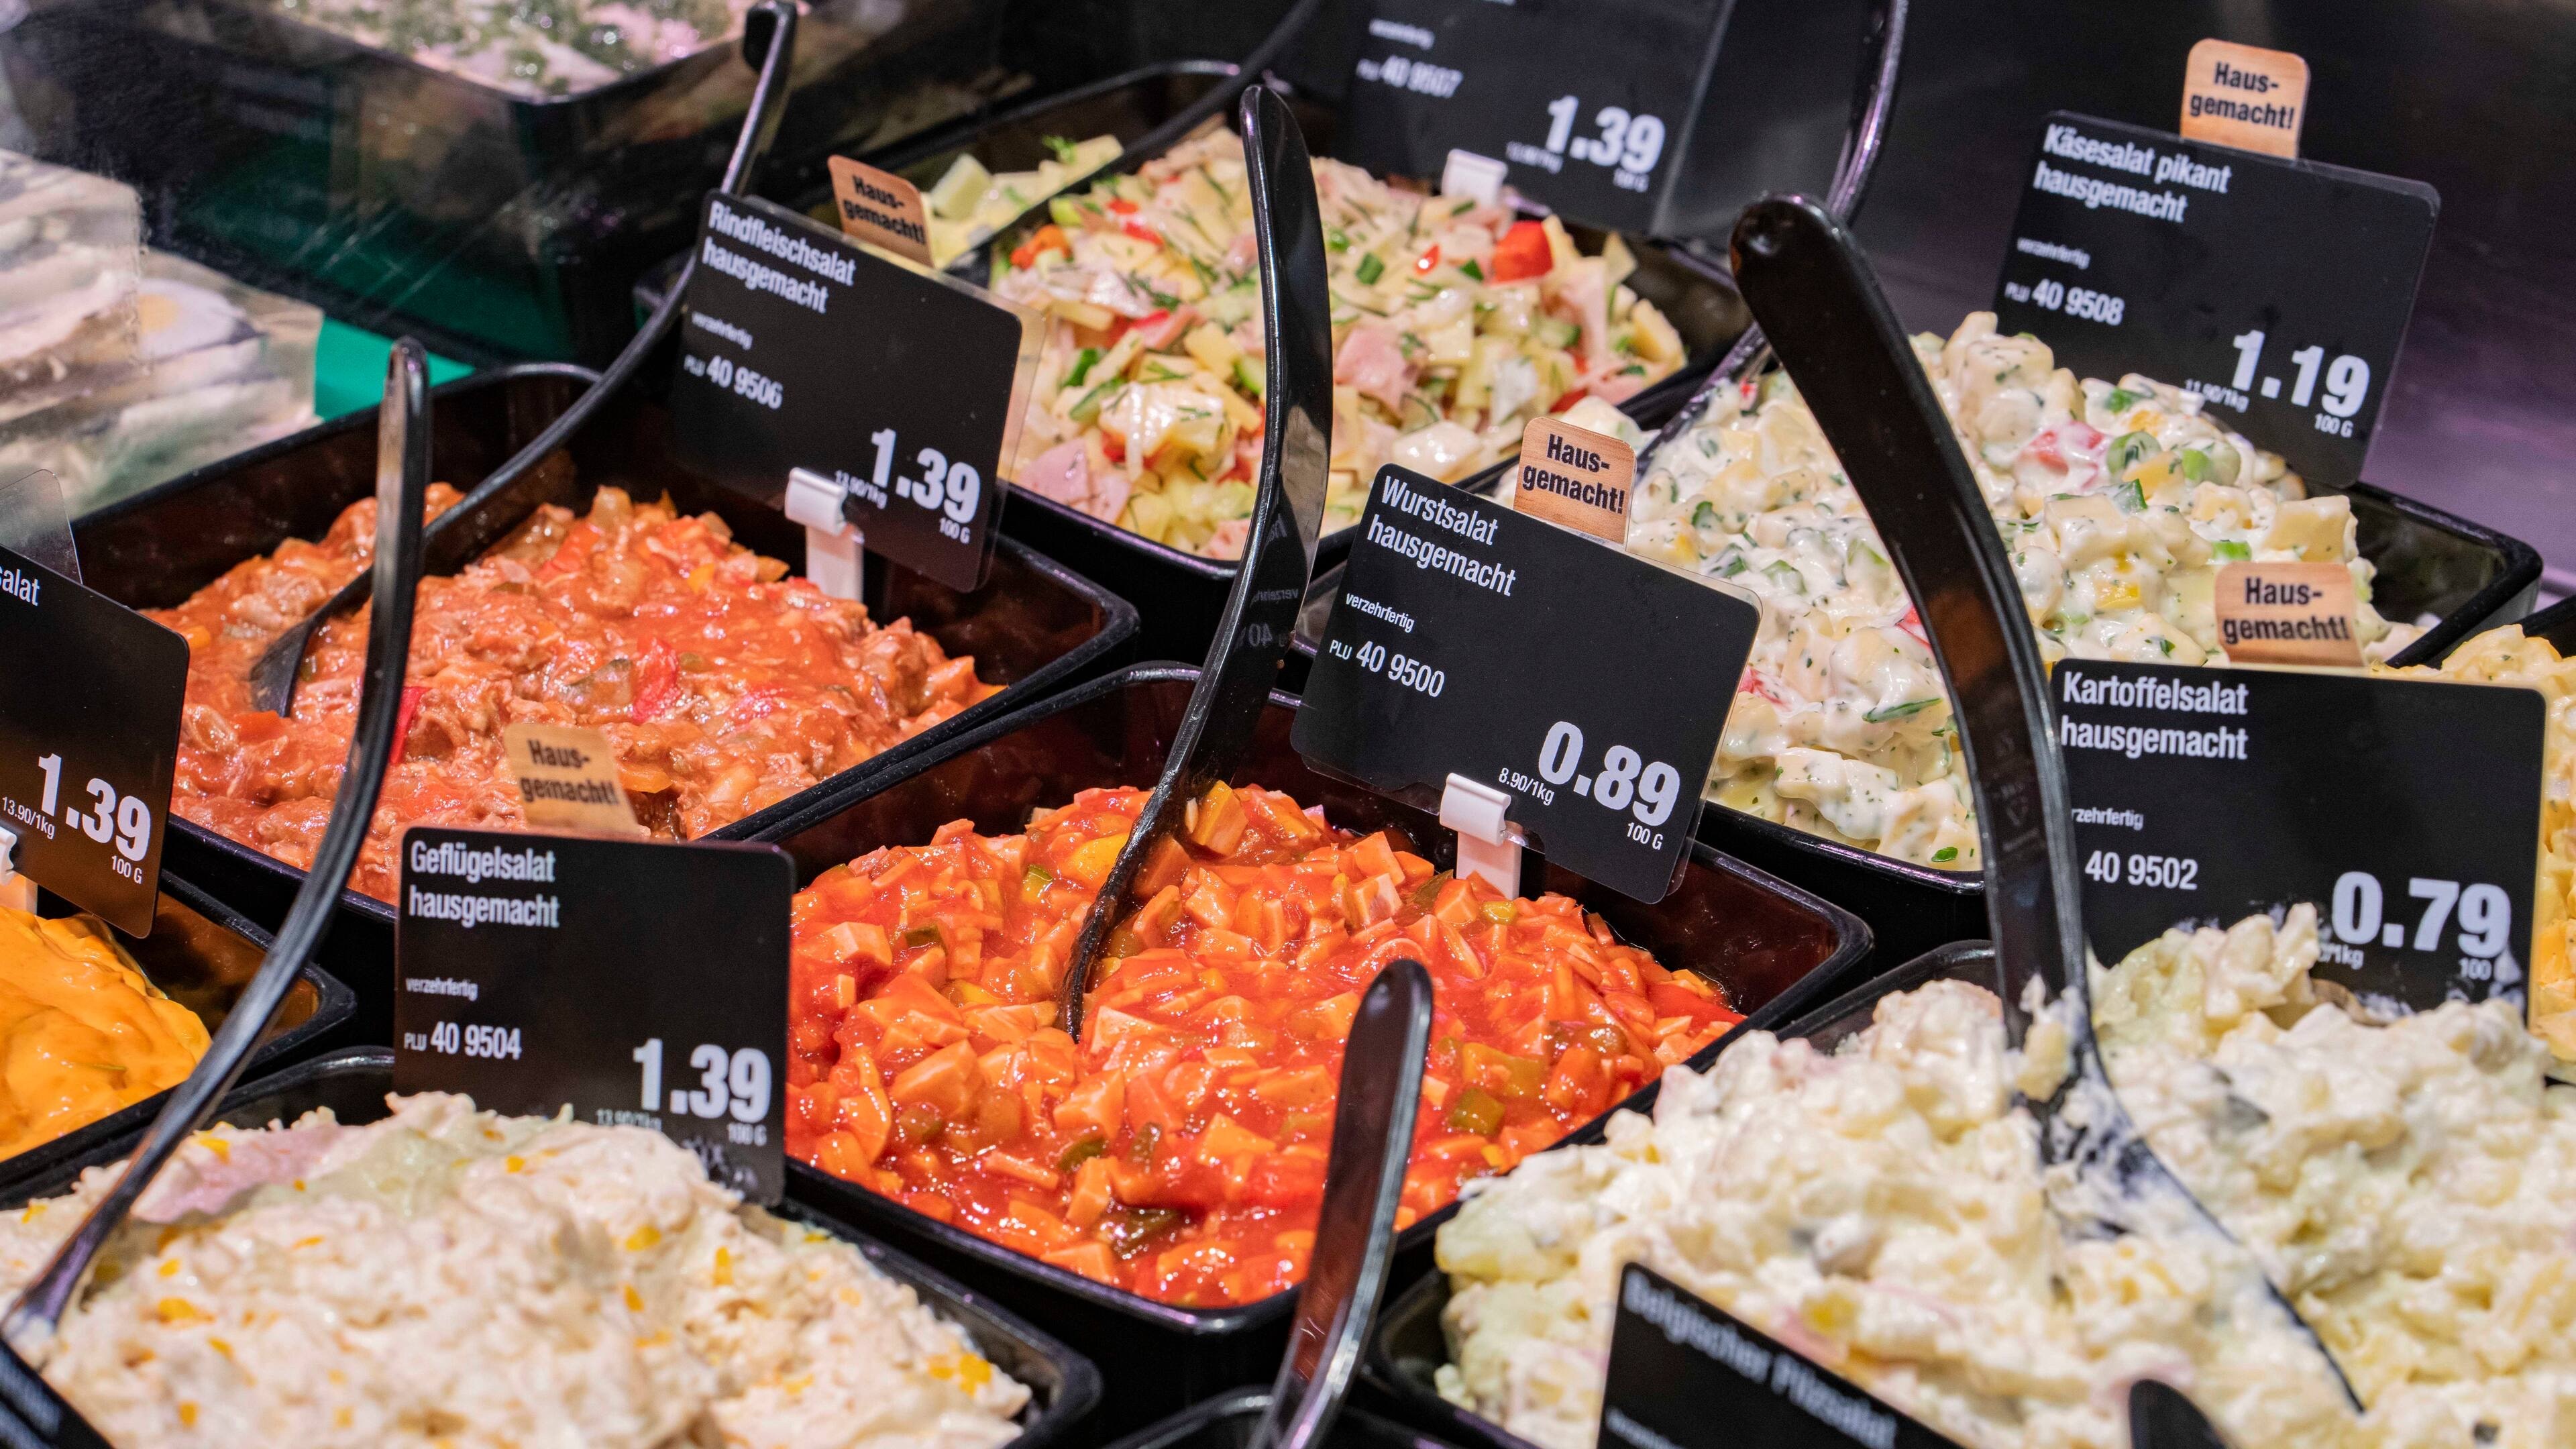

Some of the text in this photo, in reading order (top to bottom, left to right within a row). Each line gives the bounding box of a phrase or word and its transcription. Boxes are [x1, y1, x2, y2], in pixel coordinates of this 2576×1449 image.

[2214, 62, 2279, 94] Haus-
[2190, 93, 2294, 129] gemacht!
[1545, 95, 1665, 174] 1.39
[2043, 124, 2233, 195] Käsesalat pikant
[2033, 162, 2189, 223] hausgemacht
[708, 200, 857, 286] Rindfleischsalat
[702, 237, 829, 314] hausgemacht
[2031, 278, 2064, 311] 40
[2064, 286, 2125, 326] 9508
[706, 355, 733, 388] 40
[734, 366, 784, 409] 9506
[2231, 329, 2371, 419] 1.19
[2314, 413, 2354, 438] 100 G
[1546, 433, 1610, 472] Haus-
[871, 428, 981, 524] 1.39
[1522, 464, 1625, 514] gemacht!
[939, 517, 971, 544] 100 G
[1382, 476, 1499, 545] Wurstsalat
[1367, 514, 1517, 596] hausgemacht
[1346, 593, 1415, 633] verzehrfertig
[2245, 576, 2323, 606] Haus-
[2223, 615, 2351, 644] gemacht!
[1329, 639, 1446, 698] PLU 40 9500
[2063, 671, 2248, 715] Kartoffelsalat
[528, 739, 590, 768] Haus-
[2060, 715, 2248, 760] hausgemacht
[520, 777, 619, 805] gemacht!
[1498, 767, 1555, 806] 8.90/1kg
[1538, 720, 1680, 826] 0.89
[2, 796, 56, 840] 13.90/1kg
[39, 753, 152, 861] 1.39
[1627, 822, 1664, 851] 100 G
[111, 855, 143, 884] 100 G
[411, 841, 556, 883] Geflügelsalat
[2085, 850, 2198, 890] 40 9502
[409, 885, 560, 928] hausgemacht
[2332, 871, 2511, 959] 0.79
[406, 977, 478, 1002] verzehrfertig
[2459, 958, 2492, 981] 100
[404, 1021, 523, 1060] PLU 40 9504
[633, 1038, 771, 1124] 1.39
